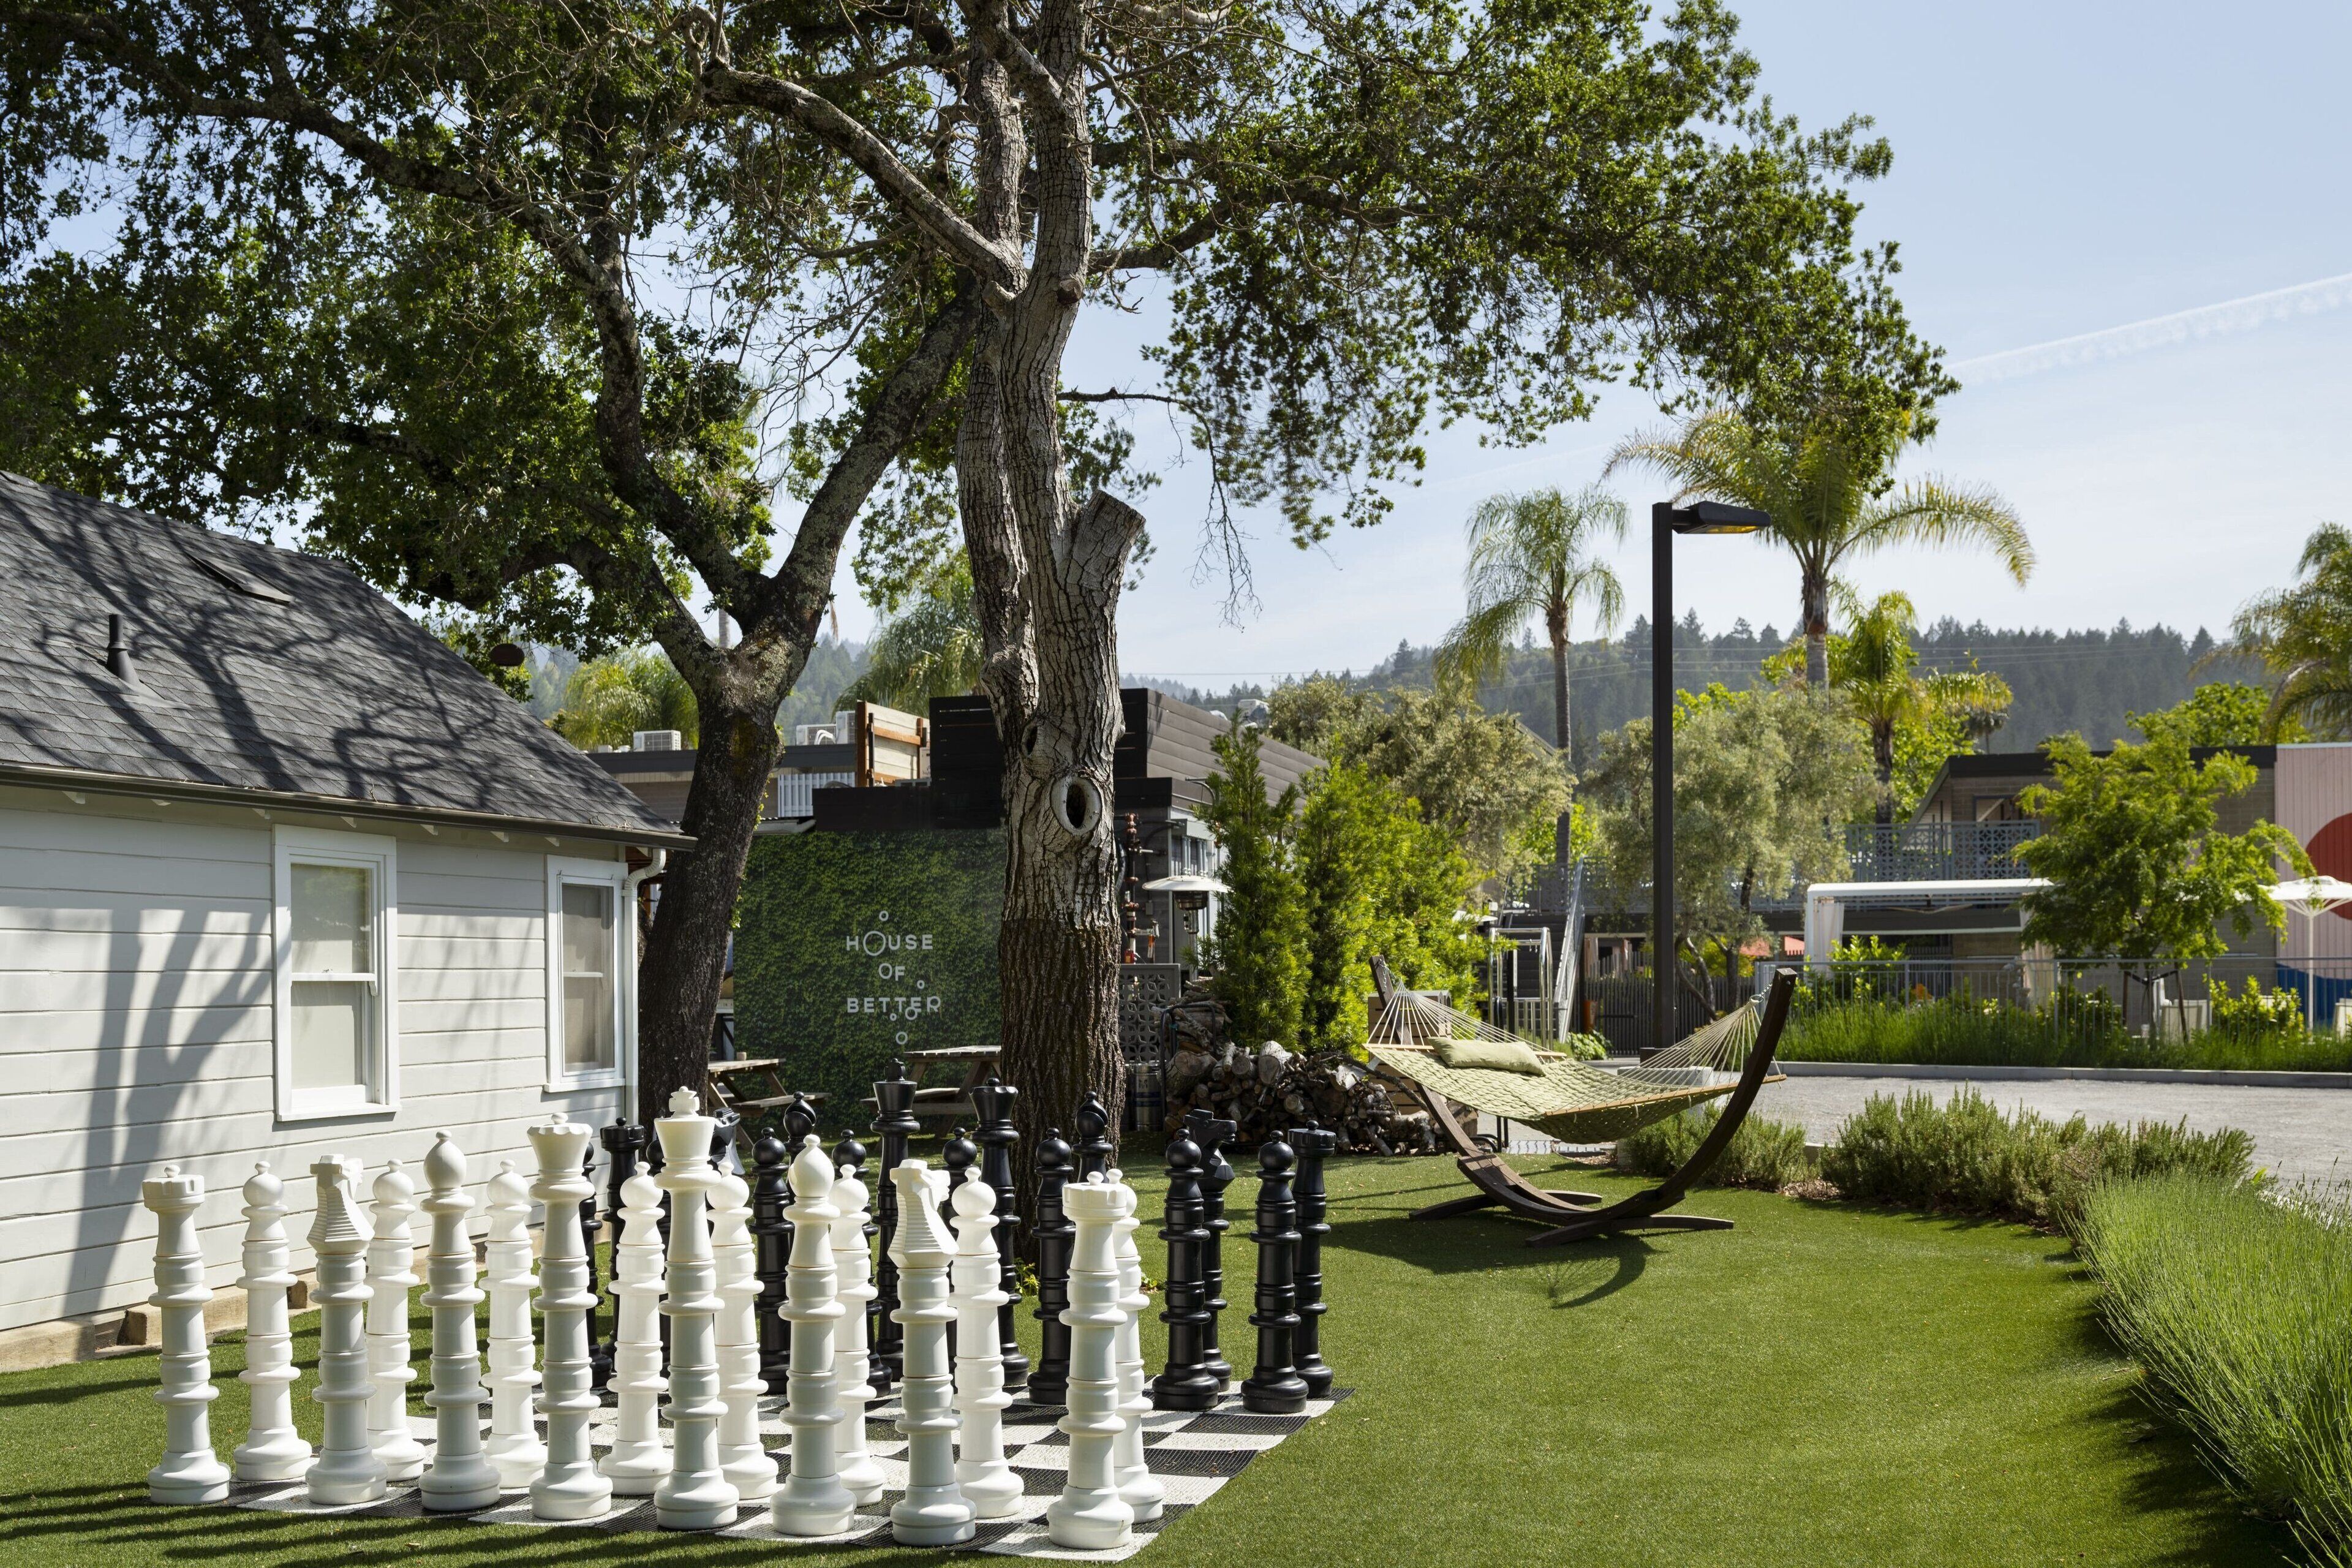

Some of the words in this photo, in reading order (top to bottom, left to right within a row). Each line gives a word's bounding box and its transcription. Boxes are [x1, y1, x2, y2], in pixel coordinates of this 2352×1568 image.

[846, 930, 933, 956] HOUSE
[878, 963, 906, 981] OF
[846, 996, 941, 1012] BETTER
